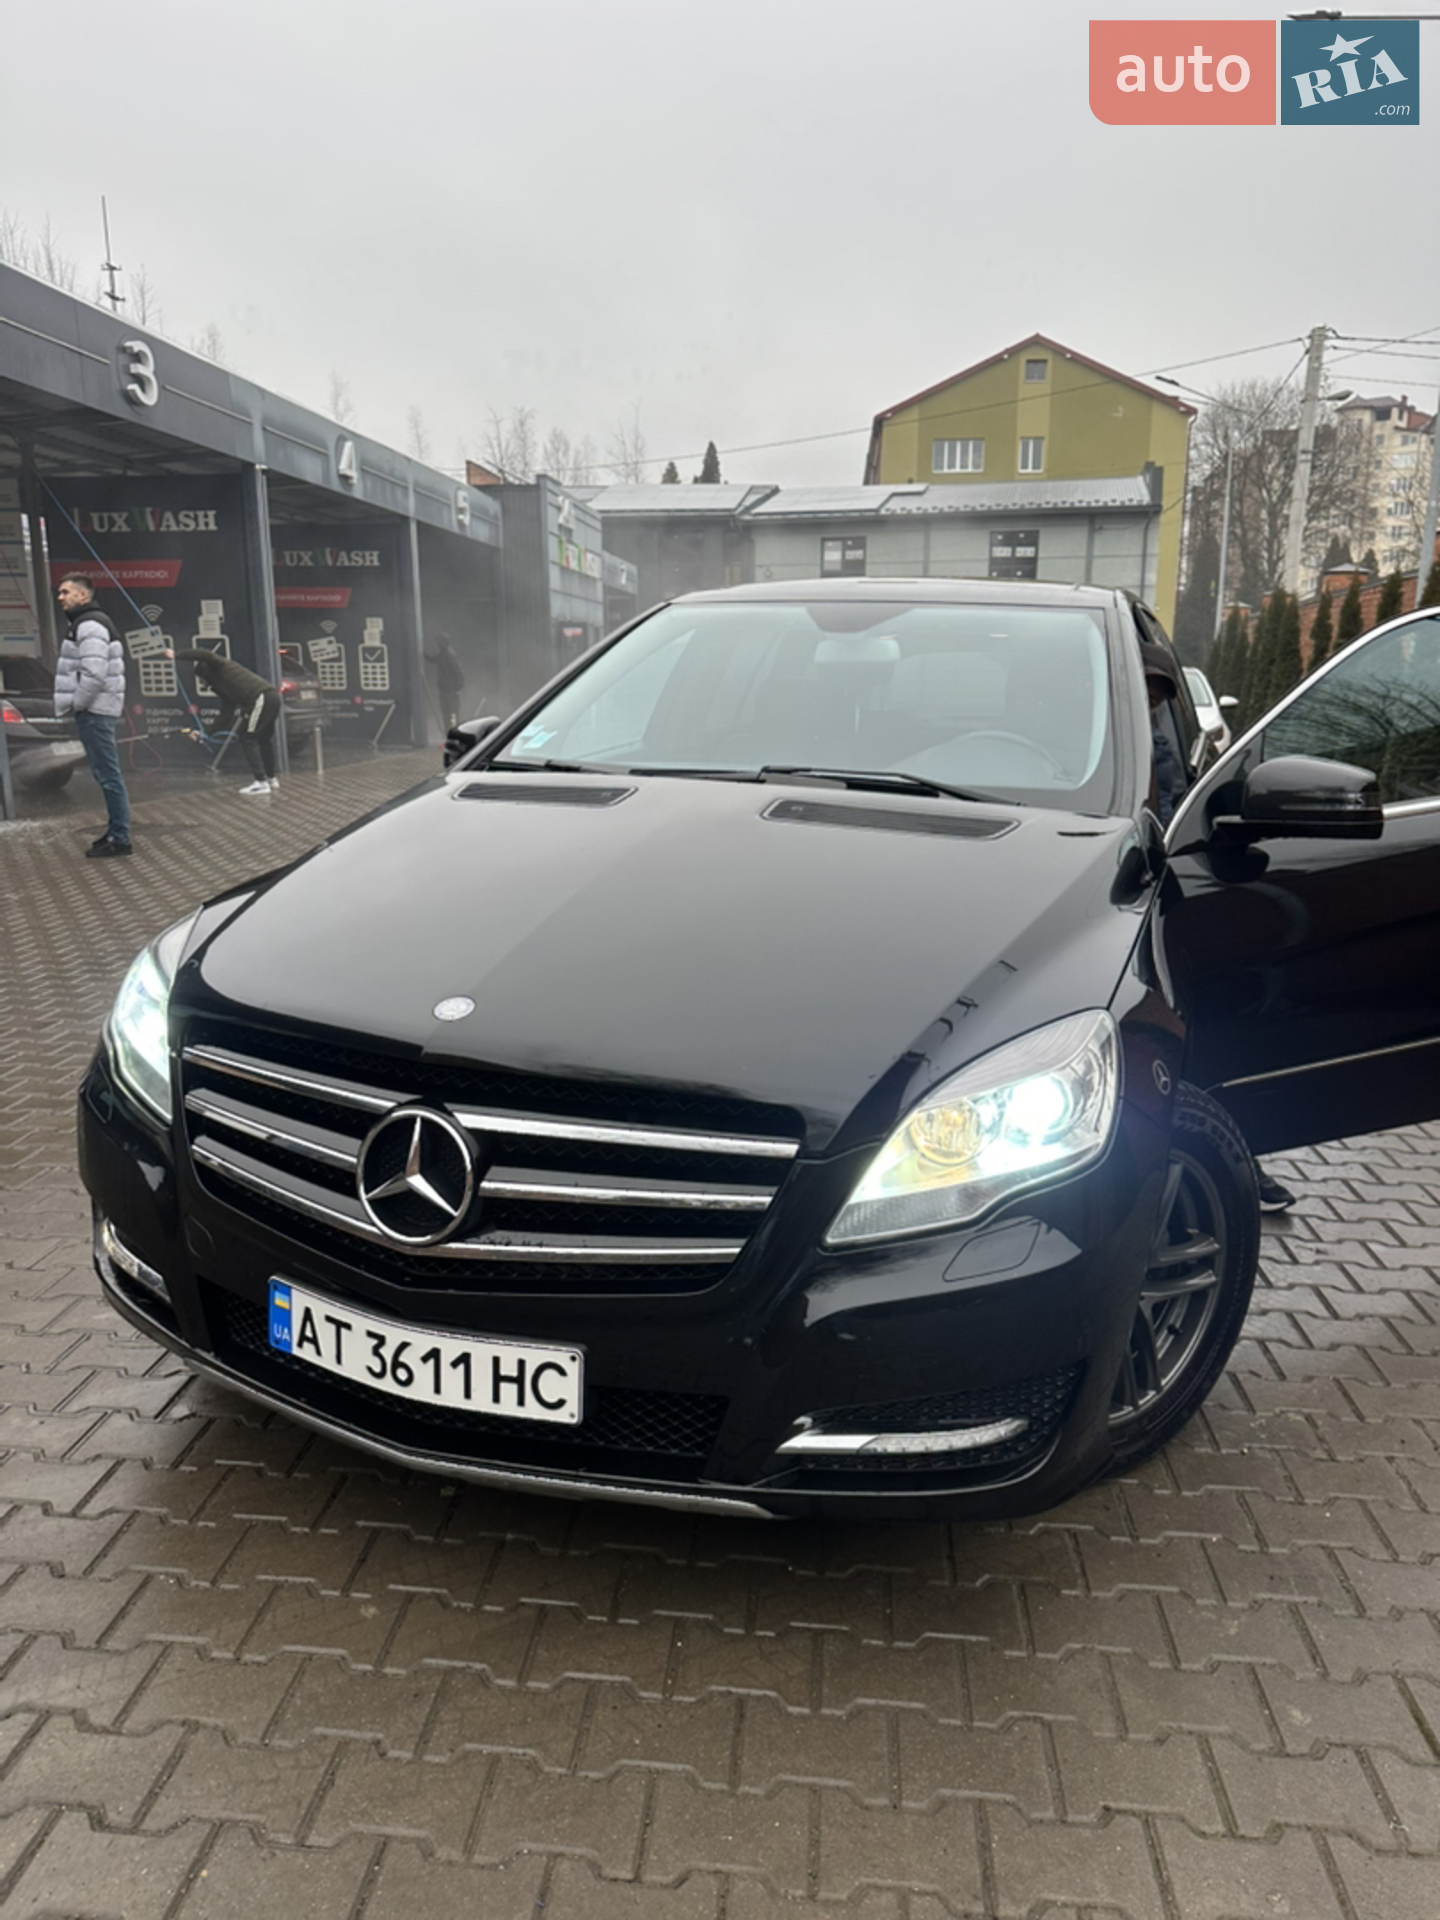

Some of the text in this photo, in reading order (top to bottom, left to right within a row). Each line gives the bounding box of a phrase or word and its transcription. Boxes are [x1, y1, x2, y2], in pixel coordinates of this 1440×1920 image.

[122, 340, 159, 407] 3
[338, 440, 358, 485] 4
[131, 507, 218, 532] WASH
[273, 1323, 291, 1342] UA
[296, 1306, 569, 1411] AT 3611 HC
